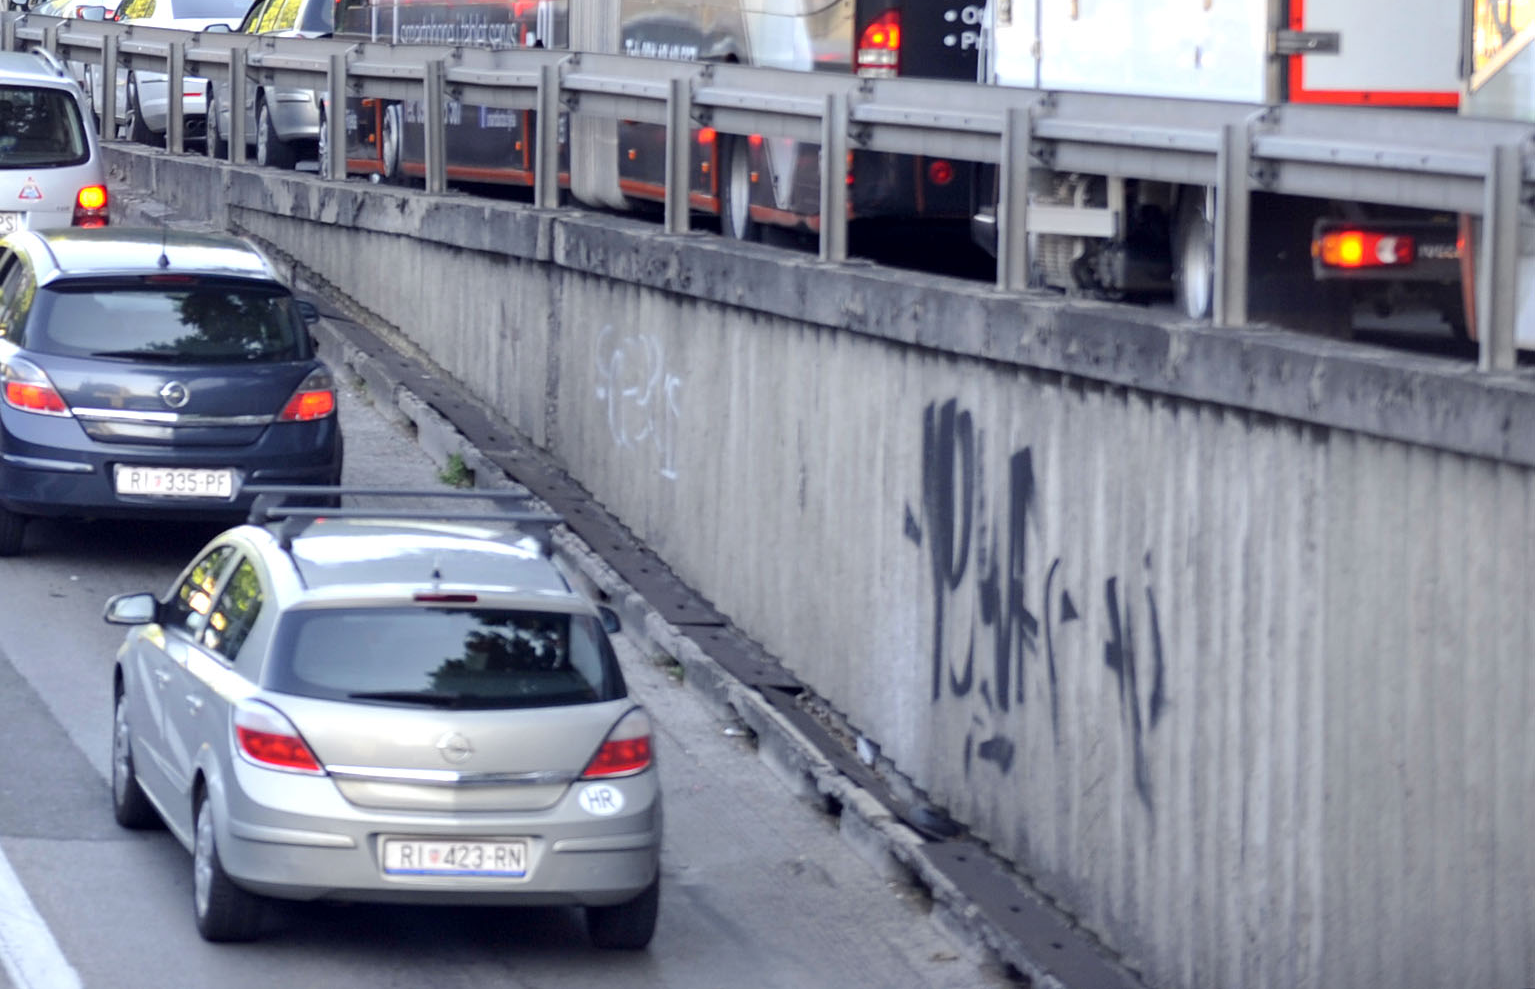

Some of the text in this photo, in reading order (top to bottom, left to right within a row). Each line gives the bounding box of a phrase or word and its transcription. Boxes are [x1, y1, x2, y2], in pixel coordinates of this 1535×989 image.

[130, 471, 227, 492] RI 335-PF
[586, 788, 616, 810] HR
[399, 845, 522, 868] RI 423-RN
